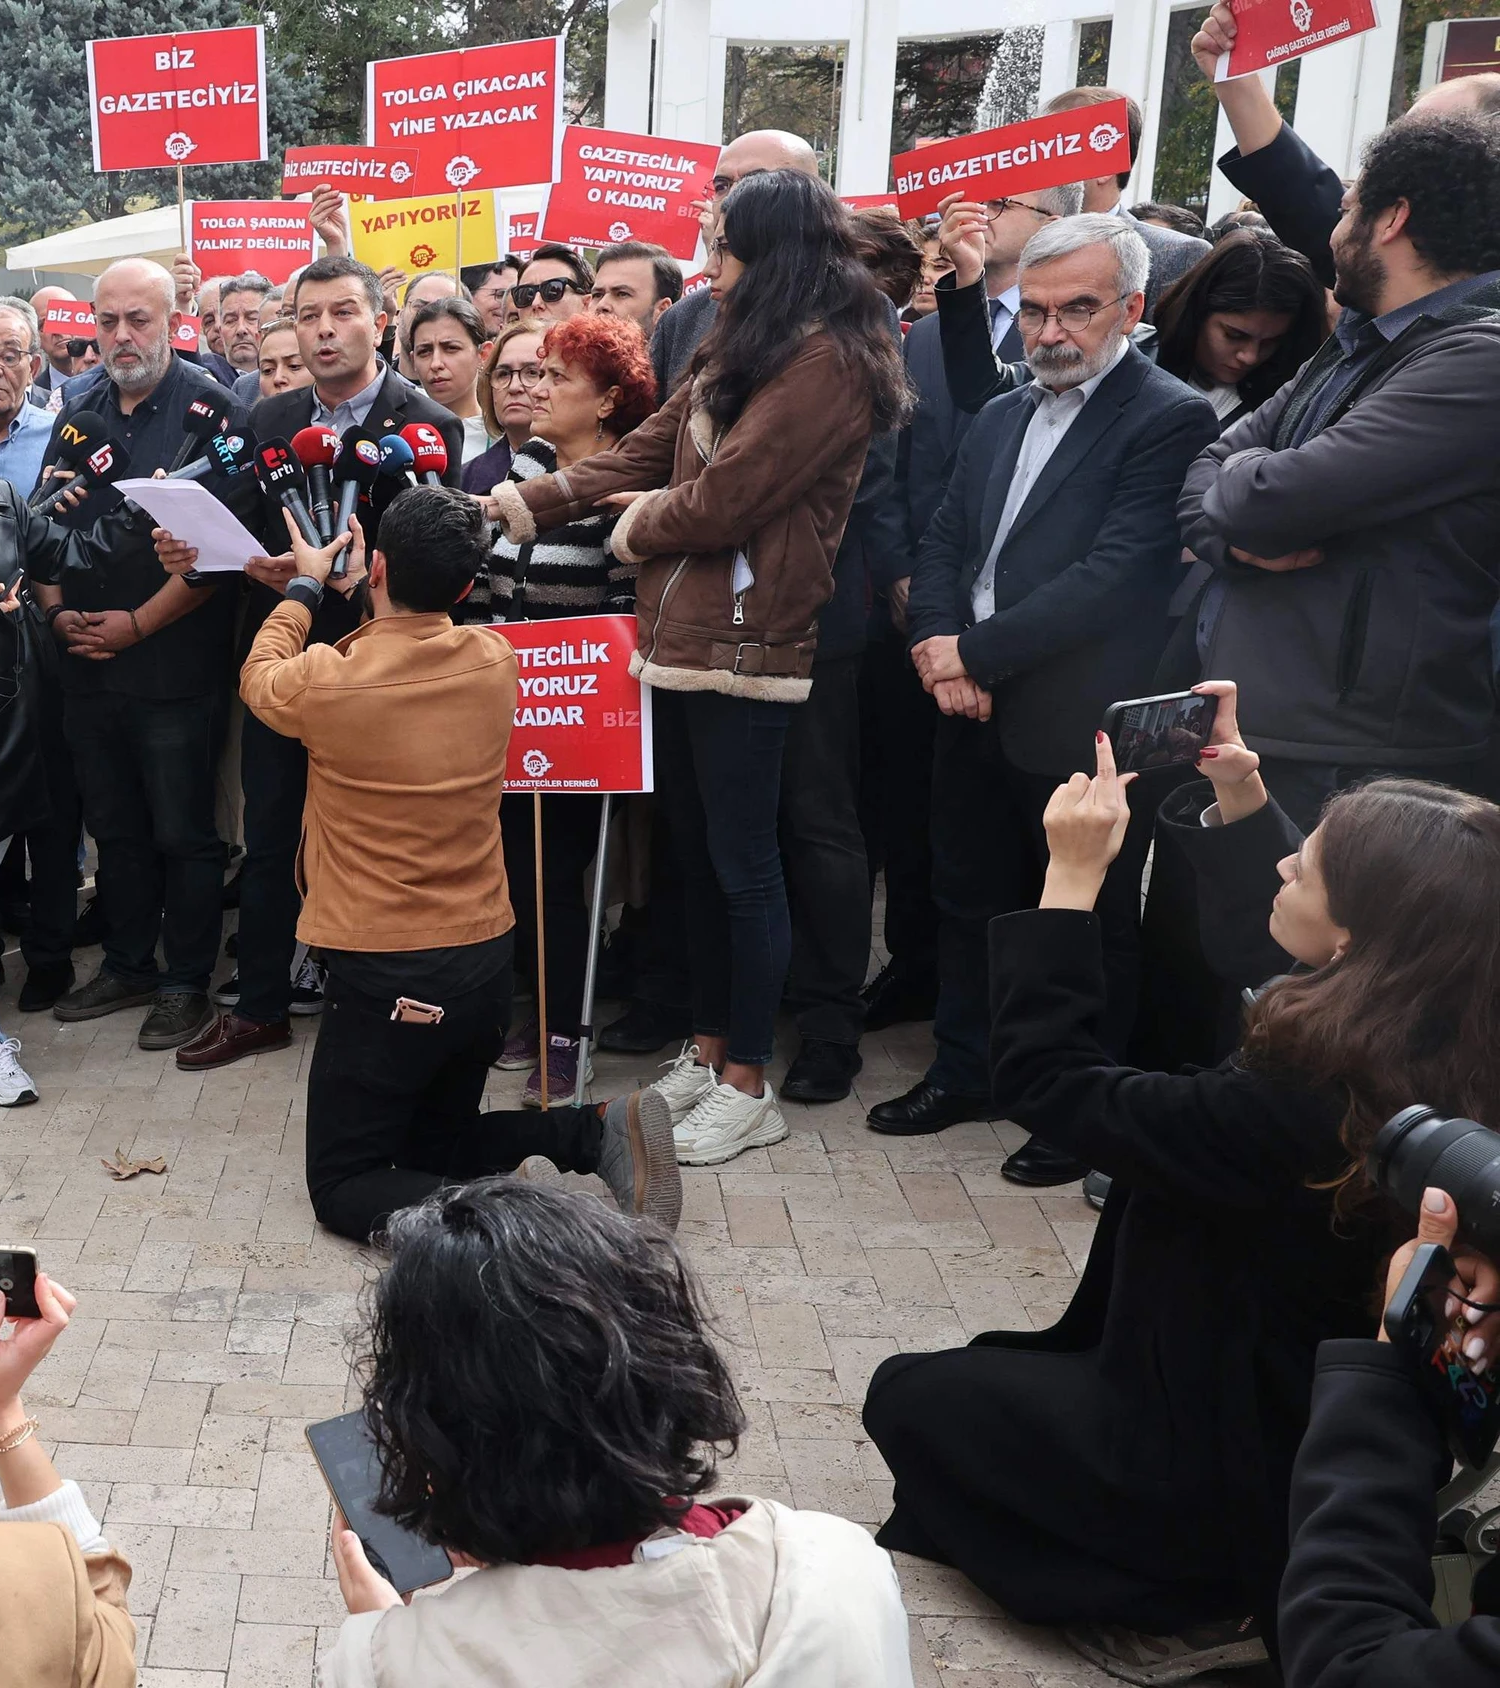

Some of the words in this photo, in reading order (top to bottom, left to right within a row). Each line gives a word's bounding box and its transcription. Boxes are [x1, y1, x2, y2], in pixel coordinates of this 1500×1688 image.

[1289, 31, 1325, 52] GAZETECİLER
[1324, 18, 1352, 39] DERNEĞİ
[155, 46, 195, 71] BİZ
[99, 81, 257, 115] GAZETECİYİZ
[382, 83, 447, 107] TOLGA
[452, 70, 547, 101] ÇIKACAK
[388, 117, 436, 137] YİNE
[441, 104, 538, 131] YAZACAK
[283, 159, 299, 178] BİZ
[299, 157, 387, 178] GAZETECİYİZ
[578, 144, 698, 175] GAZETECİLİK
[897, 170, 925, 195] BİZ
[928, 132, 1082, 186] GAZETECİYİZ
[583, 166, 683, 193] YAPIYORUZ
[587, 188, 601, 202] O
[604, 190, 667, 212] KADAR
[200, 217, 246, 229] TOLGA
[249, 216, 306, 231] ŞARDAN
[361, 199, 481, 234] YAPIYORUZ
[508, 222, 534, 237] BİZ
[194, 238, 243, 251] YALNIZ
[246, 235, 311, 251] DEĞİLDİR
[47, 308, 71, 323] BİZ
[190, 402, 208, 415] TELE
[208, 409, 214, 418] 1
[212, 435, 234, 463] KRT
[321, 433, 340, 448] FO
[417, 442, 445, 453] anka
[359, 446, 379, 461] SZC
[515, 639, 610, 668] TECİLİK
[518, 674, 598, 697] YORUZ
[603, 708, 640, 728] BİZ
[510, 778, 562, 788] GAZETECİLER
[564, 778, 598, 788] DERNEĞİ
